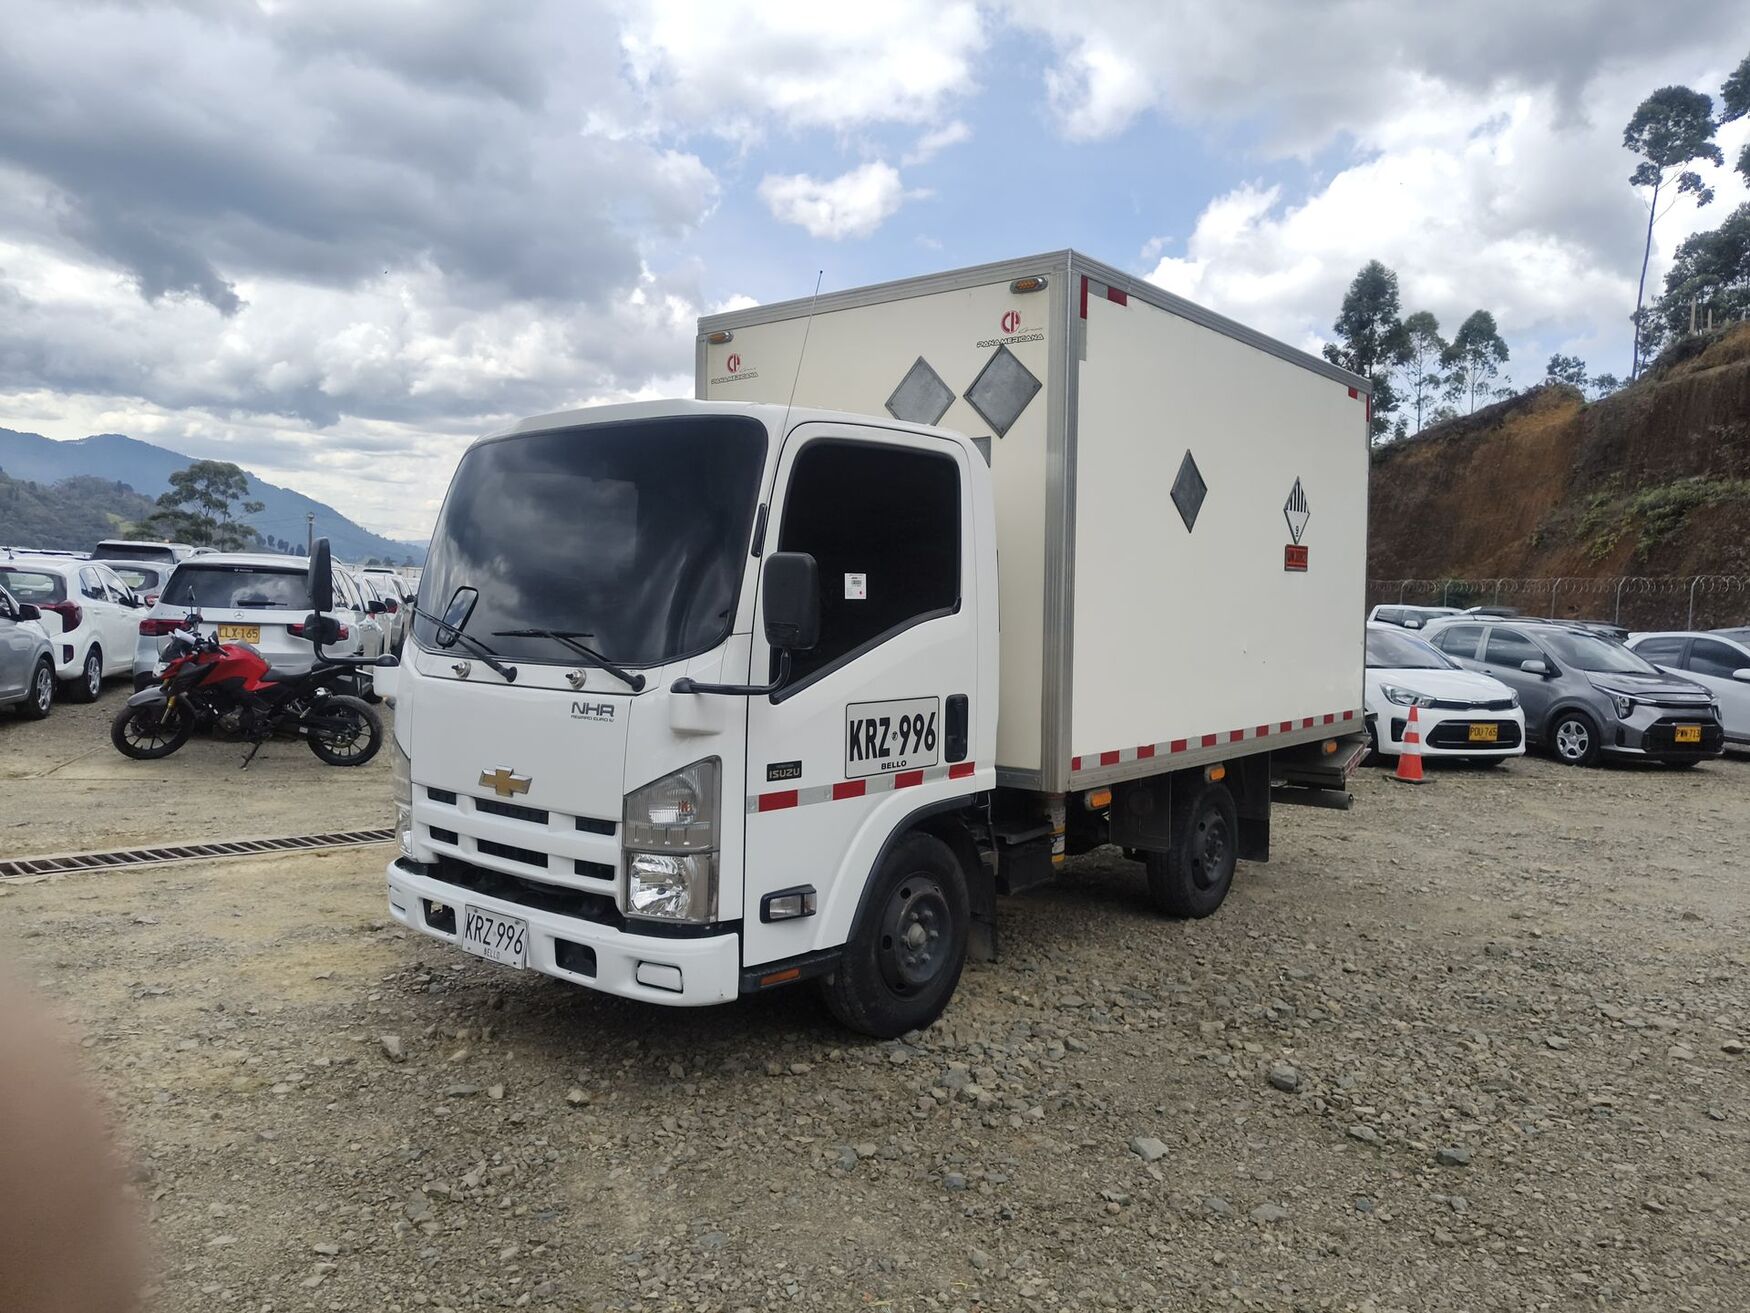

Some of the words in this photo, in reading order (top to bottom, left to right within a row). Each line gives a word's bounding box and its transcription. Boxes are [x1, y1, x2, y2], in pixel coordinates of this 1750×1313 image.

[976, 334, 1044, 348] PANAMERICANA
[571, 702, 614, 717] NHR
[881, 760, 907, 770] BELLO
[769, 768, 800, 779] ISUZU
